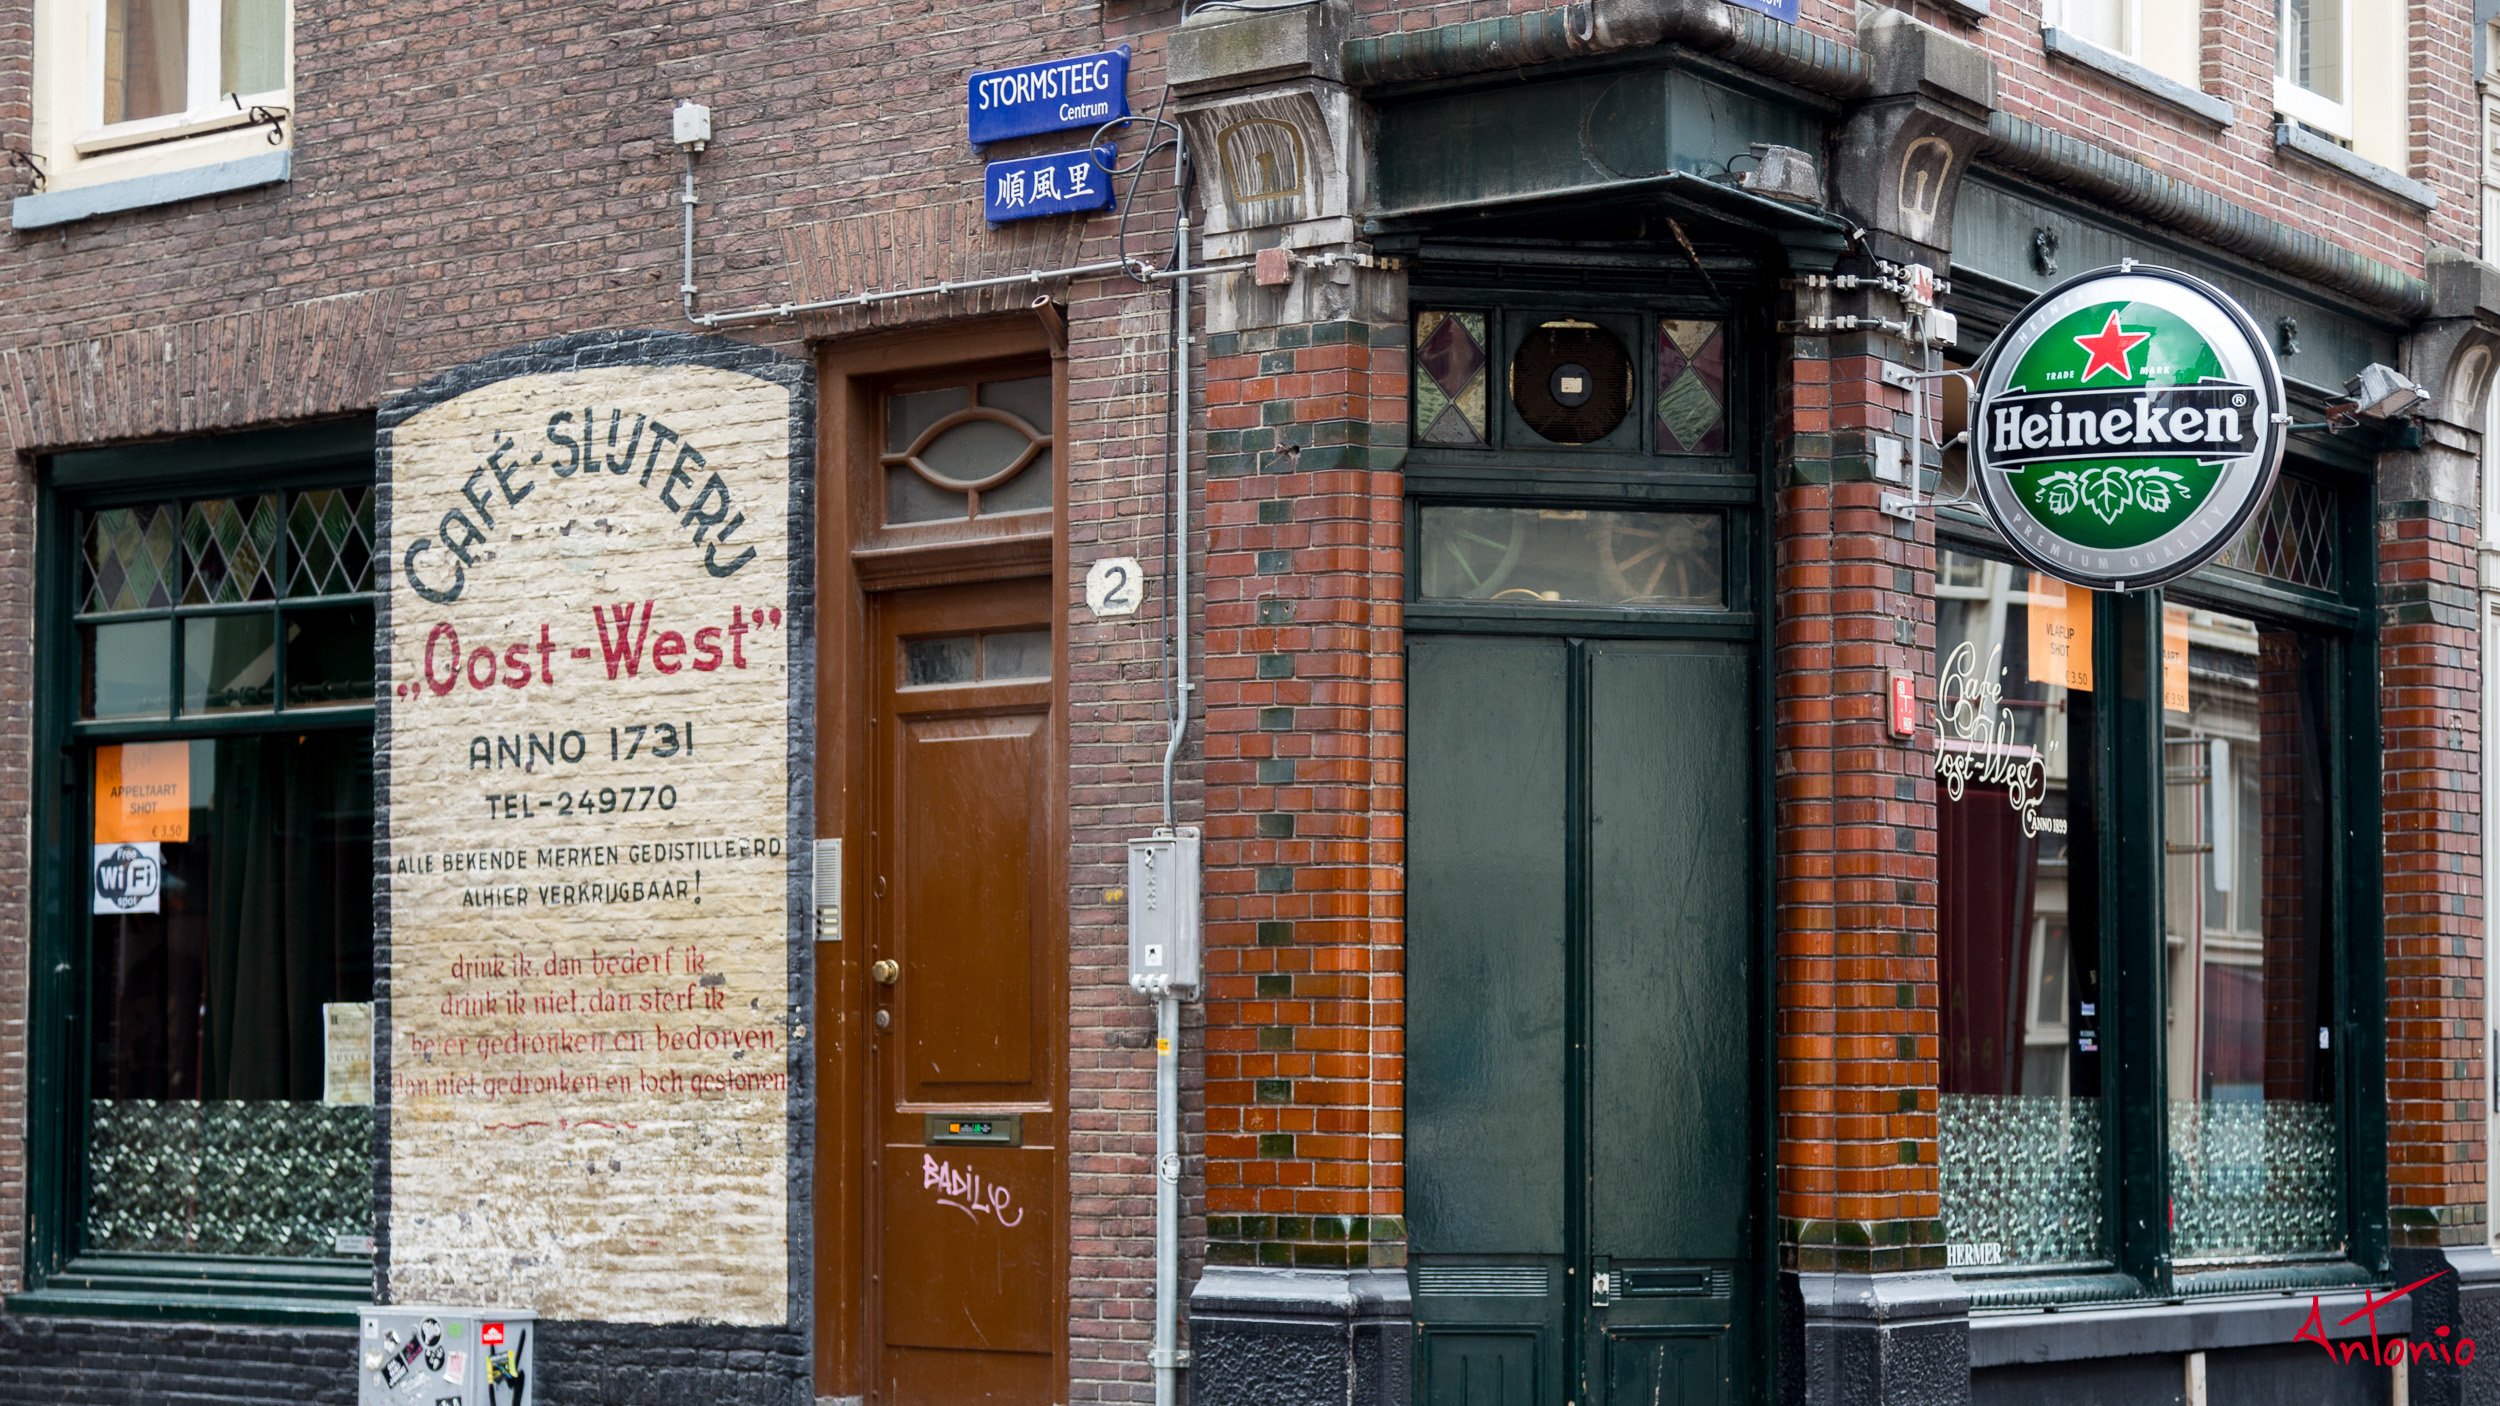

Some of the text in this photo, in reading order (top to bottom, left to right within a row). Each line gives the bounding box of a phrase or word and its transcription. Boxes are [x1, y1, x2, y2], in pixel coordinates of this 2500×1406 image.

[979, 59, 1109, 110] STORMSTEEG
[1059, 101, 1109, 122] Centrum
[995, 162, 1095, 210] 順風里
[2046, 365, 2171, 381] TRADE MARK
[1993, 397, 2243, 452] Heineken
[2012, 506, 2225, 570] PREMIUM QUALITY
[1103, 566, 1129, 608] 2
[2046, 623, 2075, 640] VLAFLIP
[2050, 642, 2070, 658] SHOT
[2071, 671, 2088, 686] 3.50
[469, 721, 694, 771] ANNO 1731
[110, 783, 178, 798] APPELTAART
[130, 801, 157, 815] SHOT
[161, 825, 182, 837] 3.50
[2030, 816, 2068, 835] ANNO 1899
[117, 848, 138, 860] Free
[397, 838, 781, 874] ALLE BEKENDE MERKEN GEDISTILLEERD
[117, 895, 138, 909] spot
[462, 887, 528, 908] ALHIER
[544, 950, 582, 977] dan
[592, 945, 675, 976] bederf
[685, 945, 705, 975] ik
[440, 990, 497, 1017] drink
[507, 989, 526, 1016] ik
[589, 987, 632, 1013] dan
[638, 982, 697, 1013] sterf
[704, 986, 725, 1011] ik
[477, 1028, 605, 1060] gedronken
[613, 1031, 645, 1052] en
[435, 1071, 476, 1095] niet
[483, 1069, 600, 1100] gedronken
[606, 1073, 632, 1094] en
